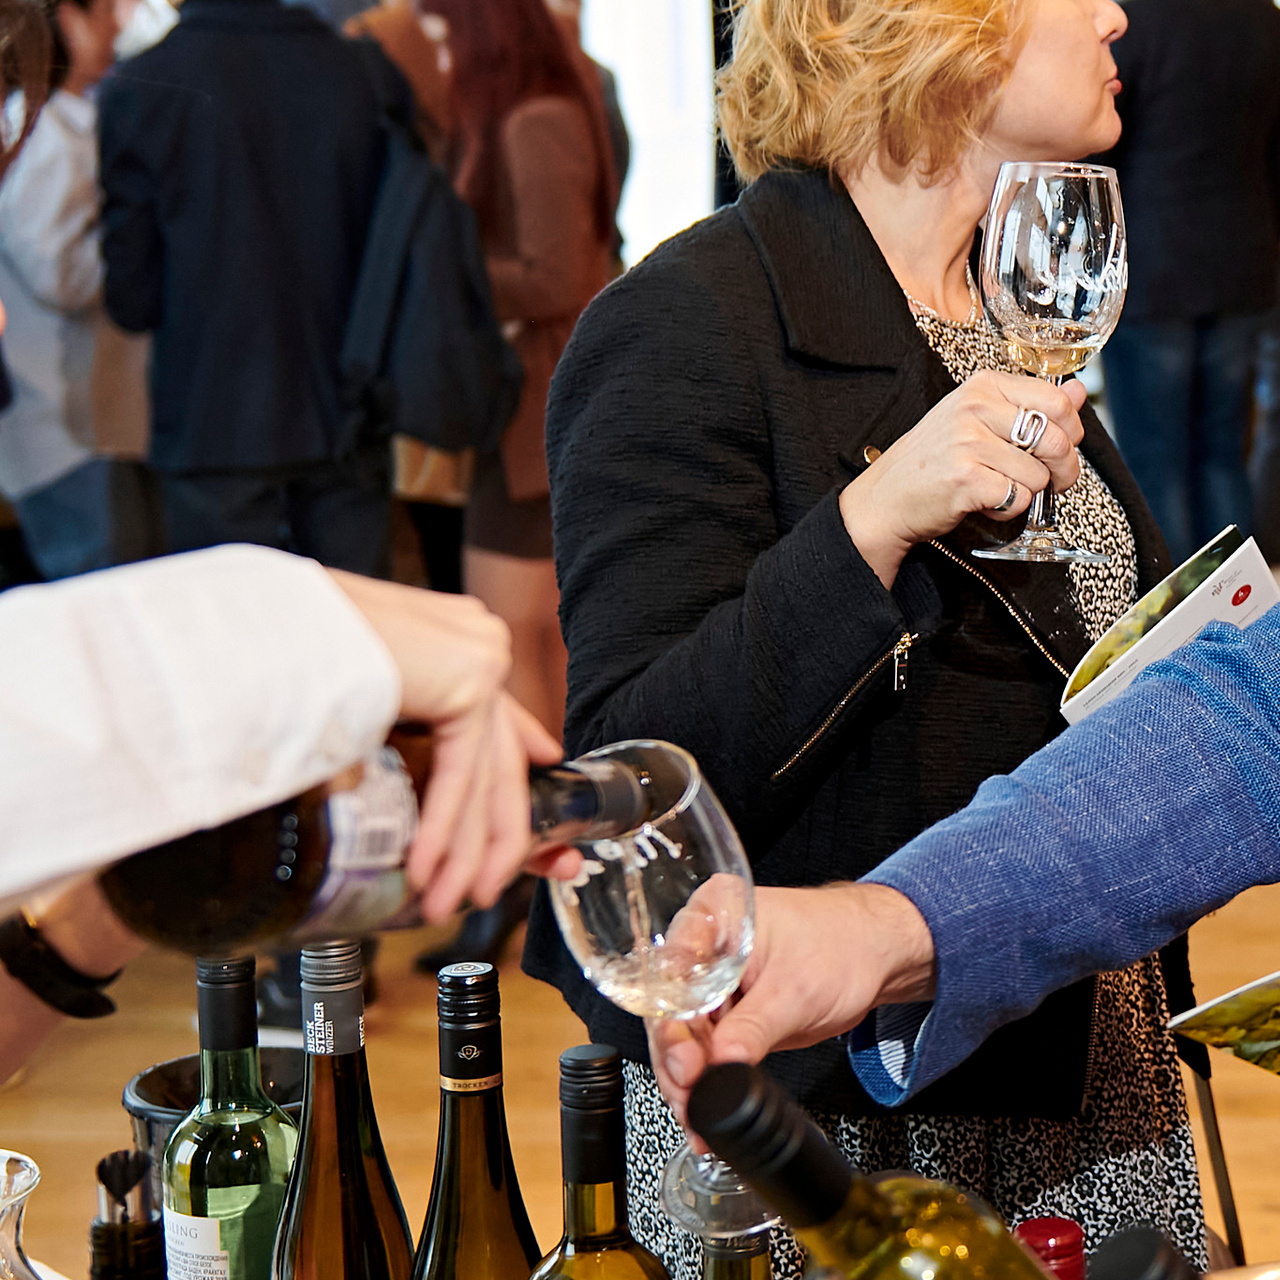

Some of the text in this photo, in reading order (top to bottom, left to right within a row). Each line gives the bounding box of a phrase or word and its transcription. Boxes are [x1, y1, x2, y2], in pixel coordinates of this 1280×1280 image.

[306, 1020, 316, 1053] BECK
[313, 1002, 326, 1054] STEINER
[325, 1020, 335, 1054] WINZER
